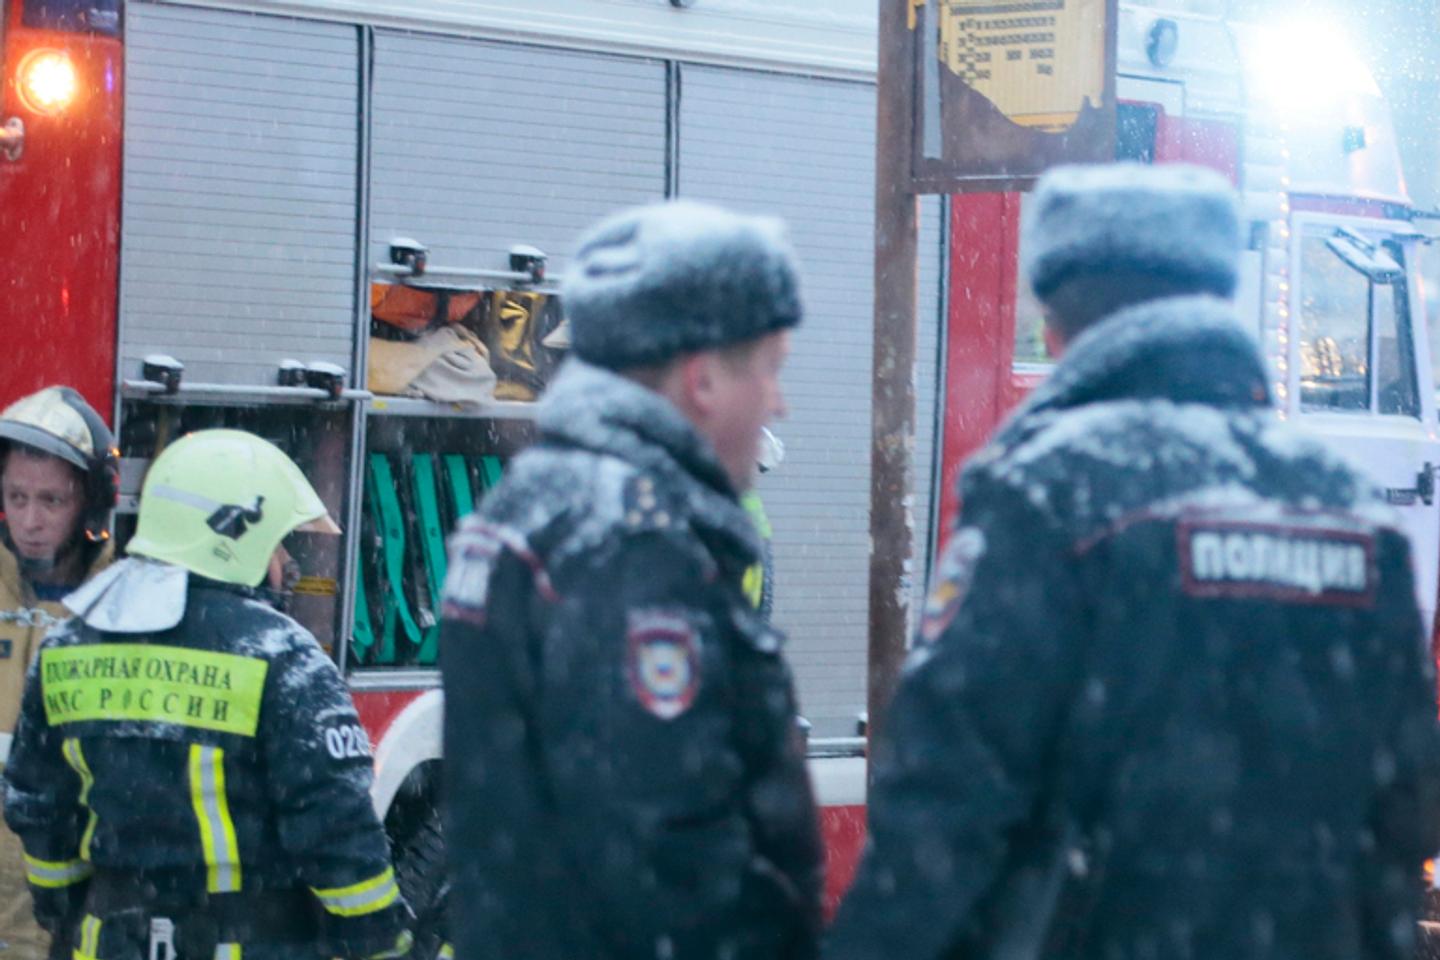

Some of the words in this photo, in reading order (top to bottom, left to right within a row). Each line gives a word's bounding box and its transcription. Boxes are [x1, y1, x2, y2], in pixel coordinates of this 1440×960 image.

[1191, 531, 1367, 597] ПОЛИЦИЯ
[45, 656, 142, 684] ПОЖАРНАЯ
[145, 656, 232, 690] ОХРАНА
[47, 688, 84, 716] МЧС
[100, 687, 230, 722] РОССИИ
